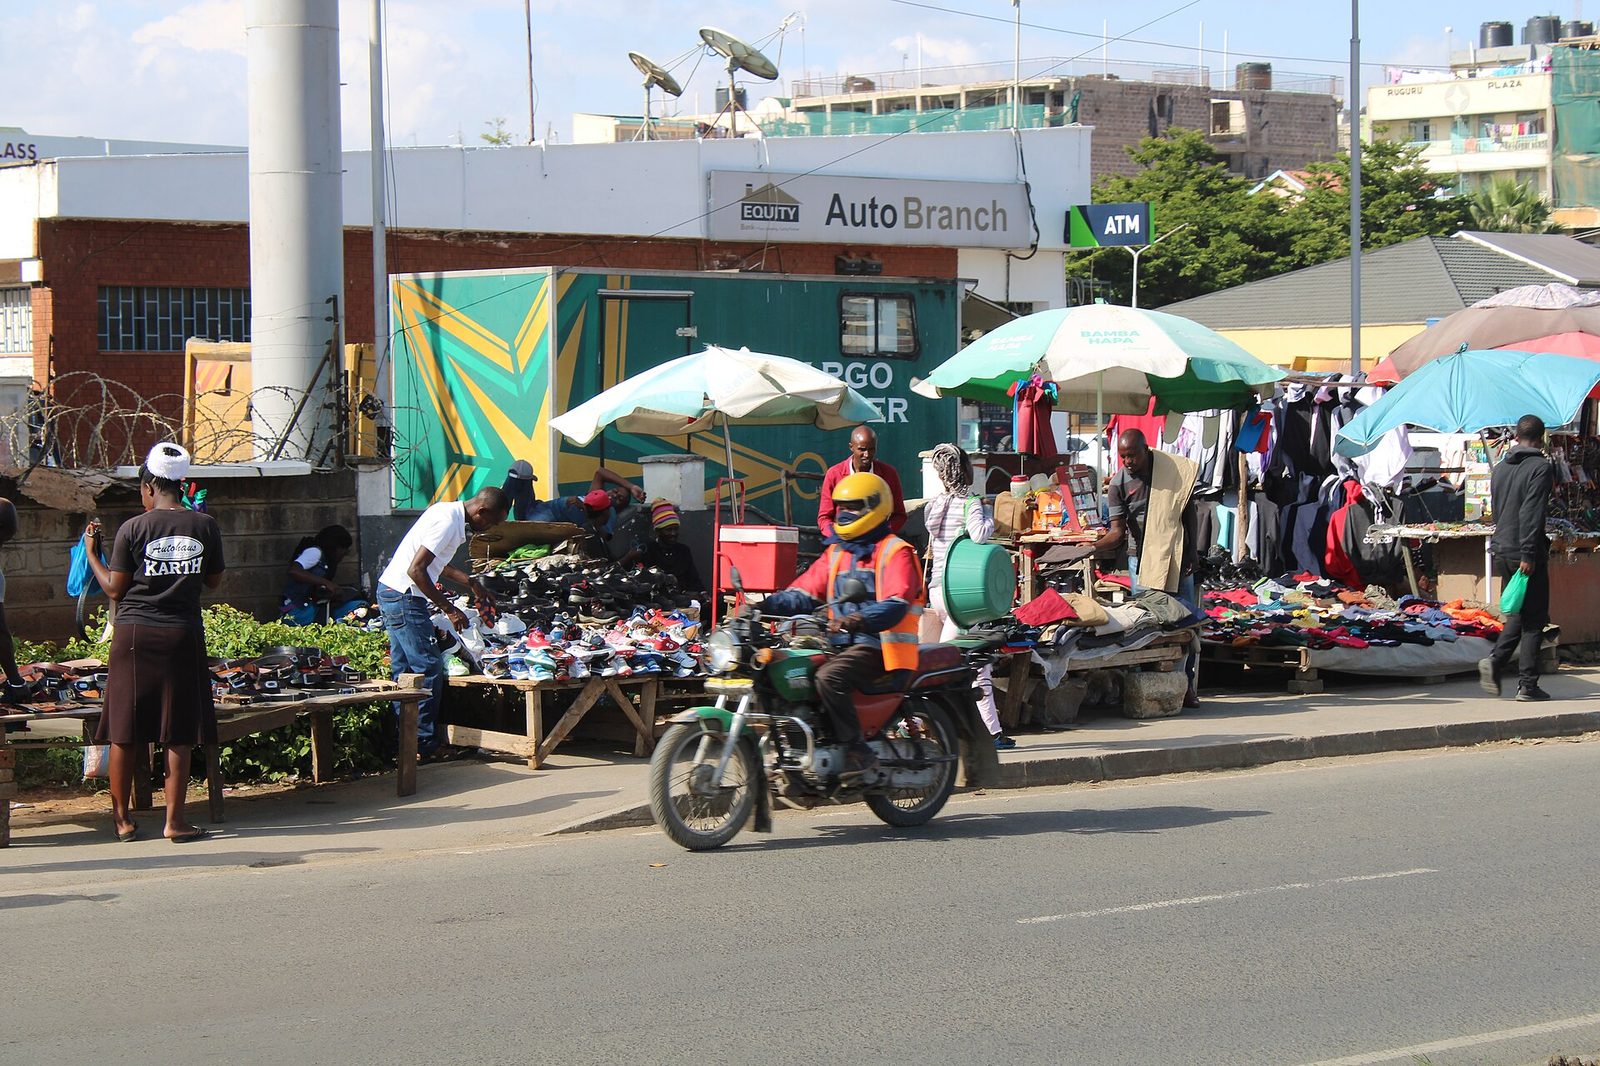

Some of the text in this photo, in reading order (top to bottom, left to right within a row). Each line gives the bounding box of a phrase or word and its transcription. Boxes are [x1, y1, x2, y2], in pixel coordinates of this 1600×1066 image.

[1387, 79, 1522, 97] RUGURU PLAZA
[0, 142, 37, 160] ASS
[743, 204, 797, 220] EQUITY
[1104, 214, 1140, 235] ATM
[1080, 330, 1141, 338] BAMBA
[1088, 337, 1134, 345] HAPA
[804, 361, 893, 390] RGO
[151, 541, 198, 555] Autohaus
[143, 556, 204, 577] KARTH
